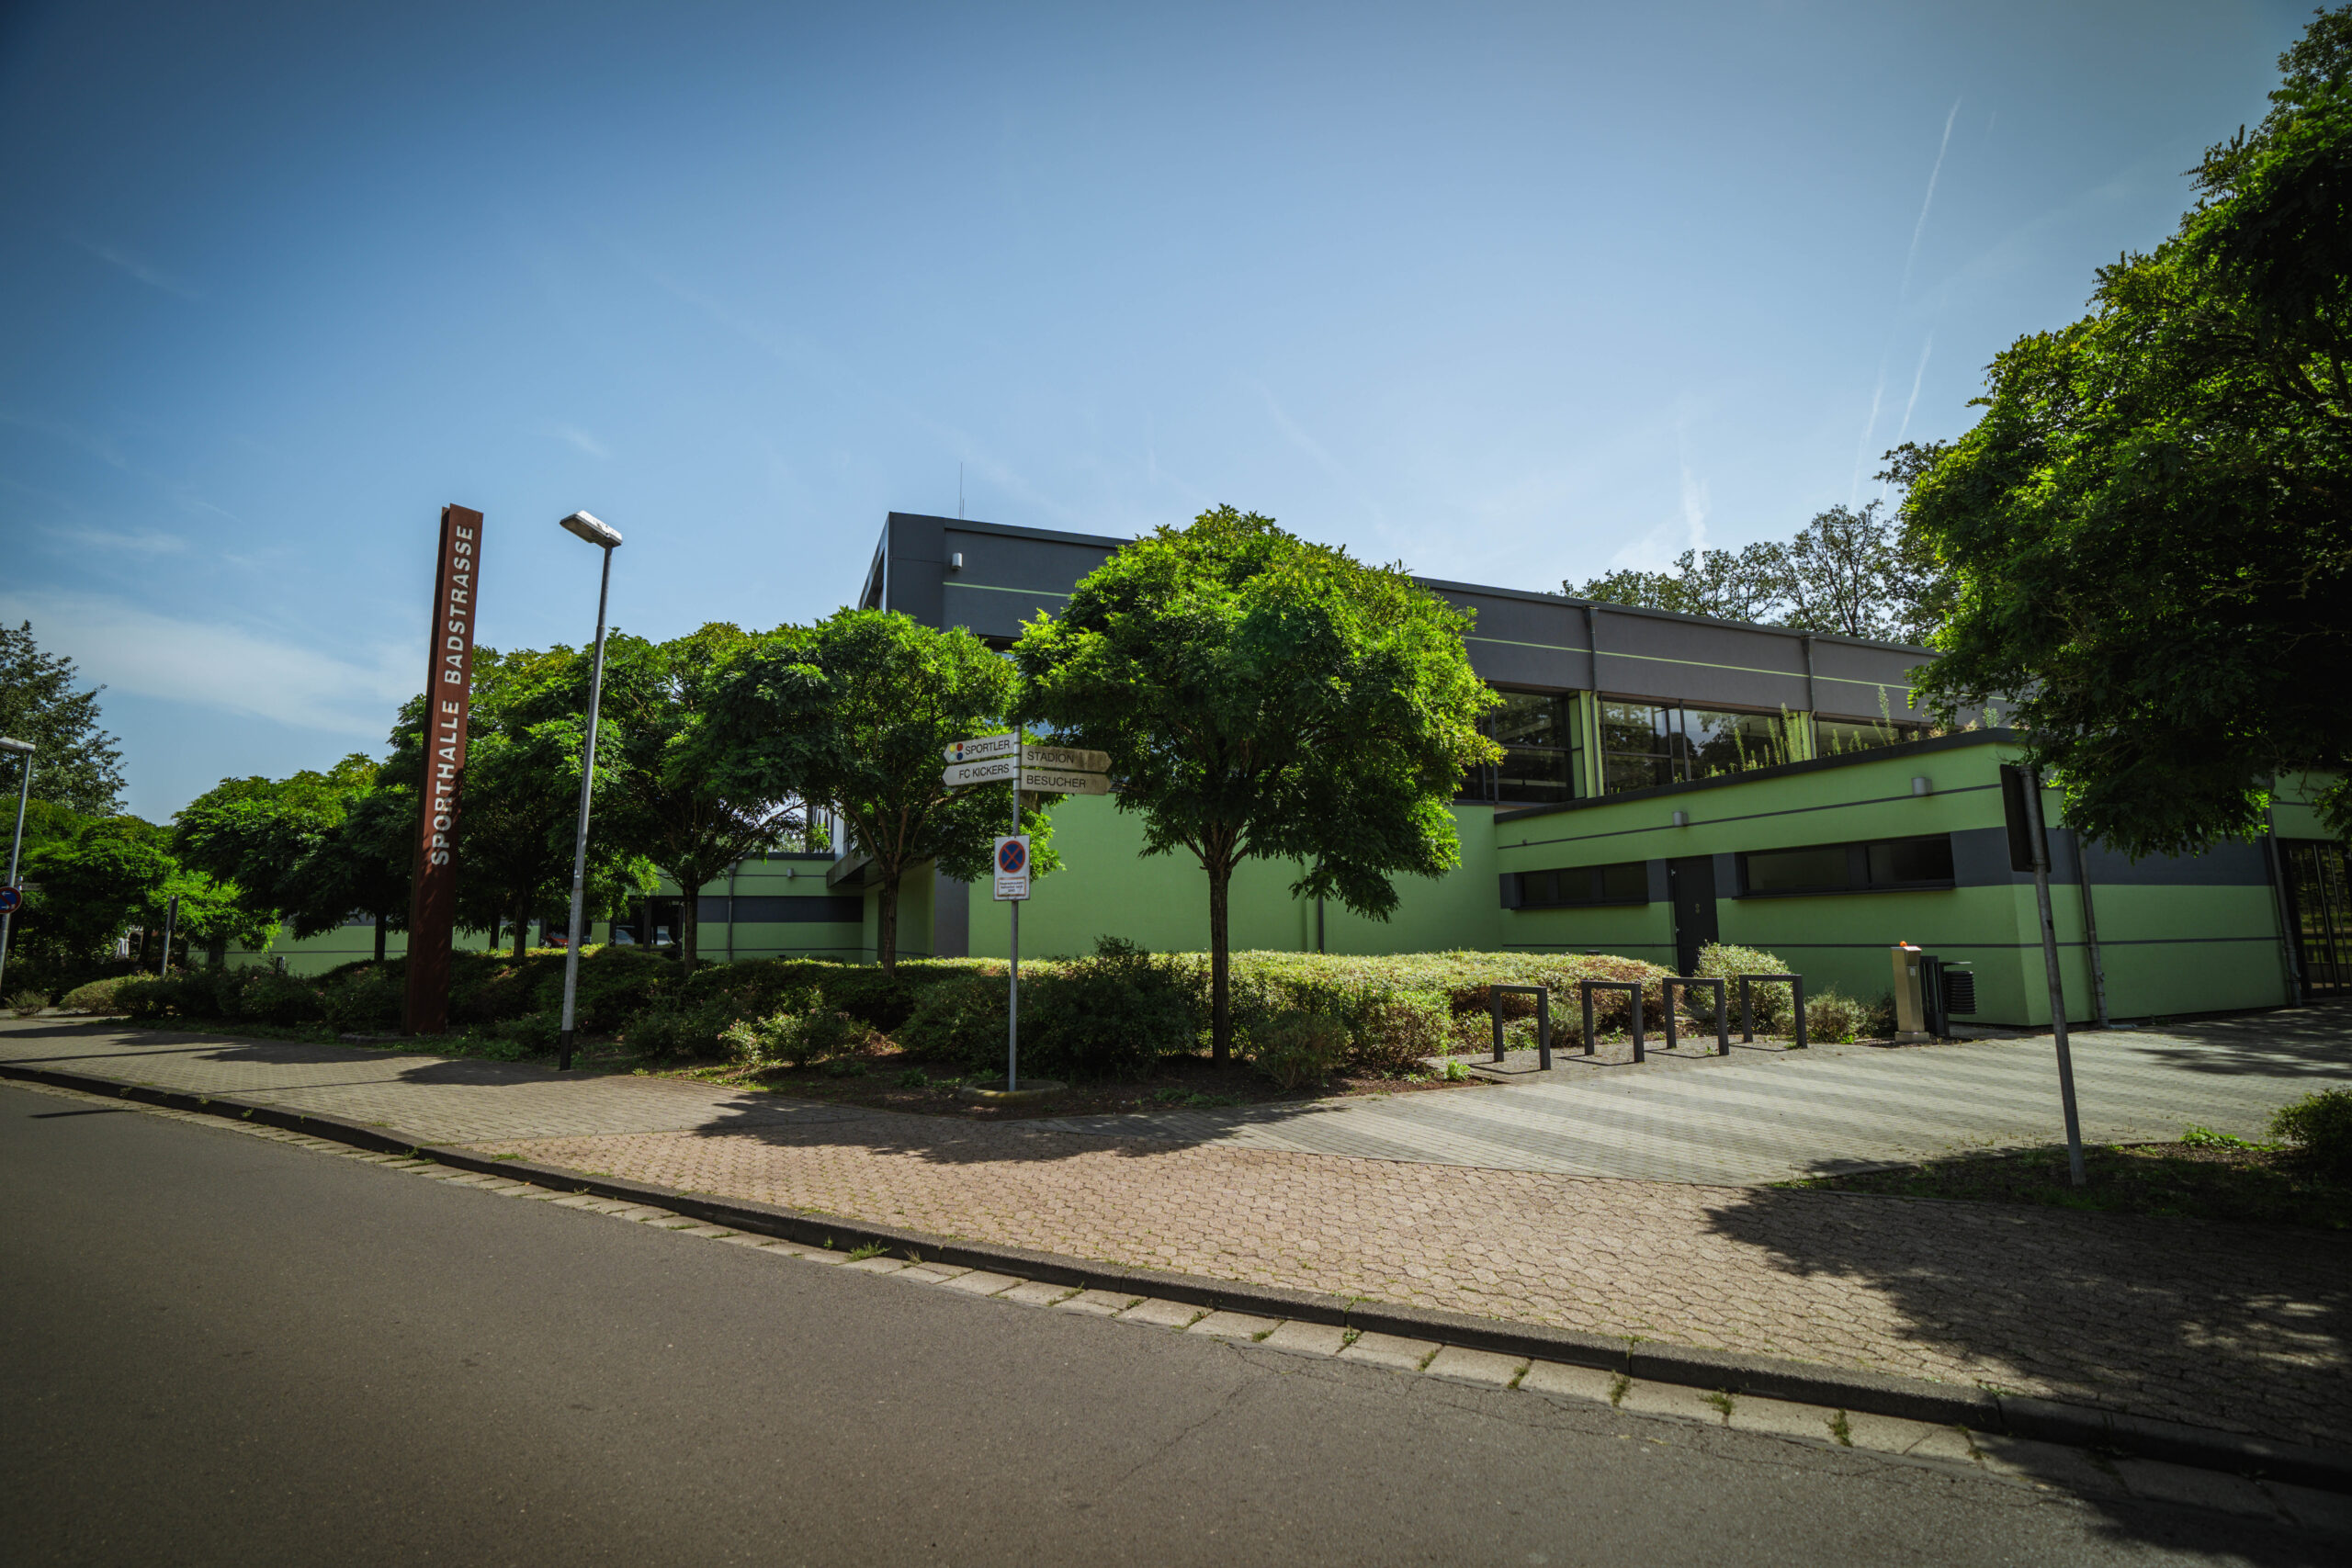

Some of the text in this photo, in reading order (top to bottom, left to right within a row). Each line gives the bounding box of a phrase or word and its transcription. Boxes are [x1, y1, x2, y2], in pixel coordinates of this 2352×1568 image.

[432, 525, 473, 865] SPORTHALLE BADSTRASSE
[965, 739, 1010, 755] SPORTLER
[1027, 751, 1074, 763] STADION
[959, 764, 1010, 779] FC KICKERS
[1026, 775, 1086, 788] BESUCHER
